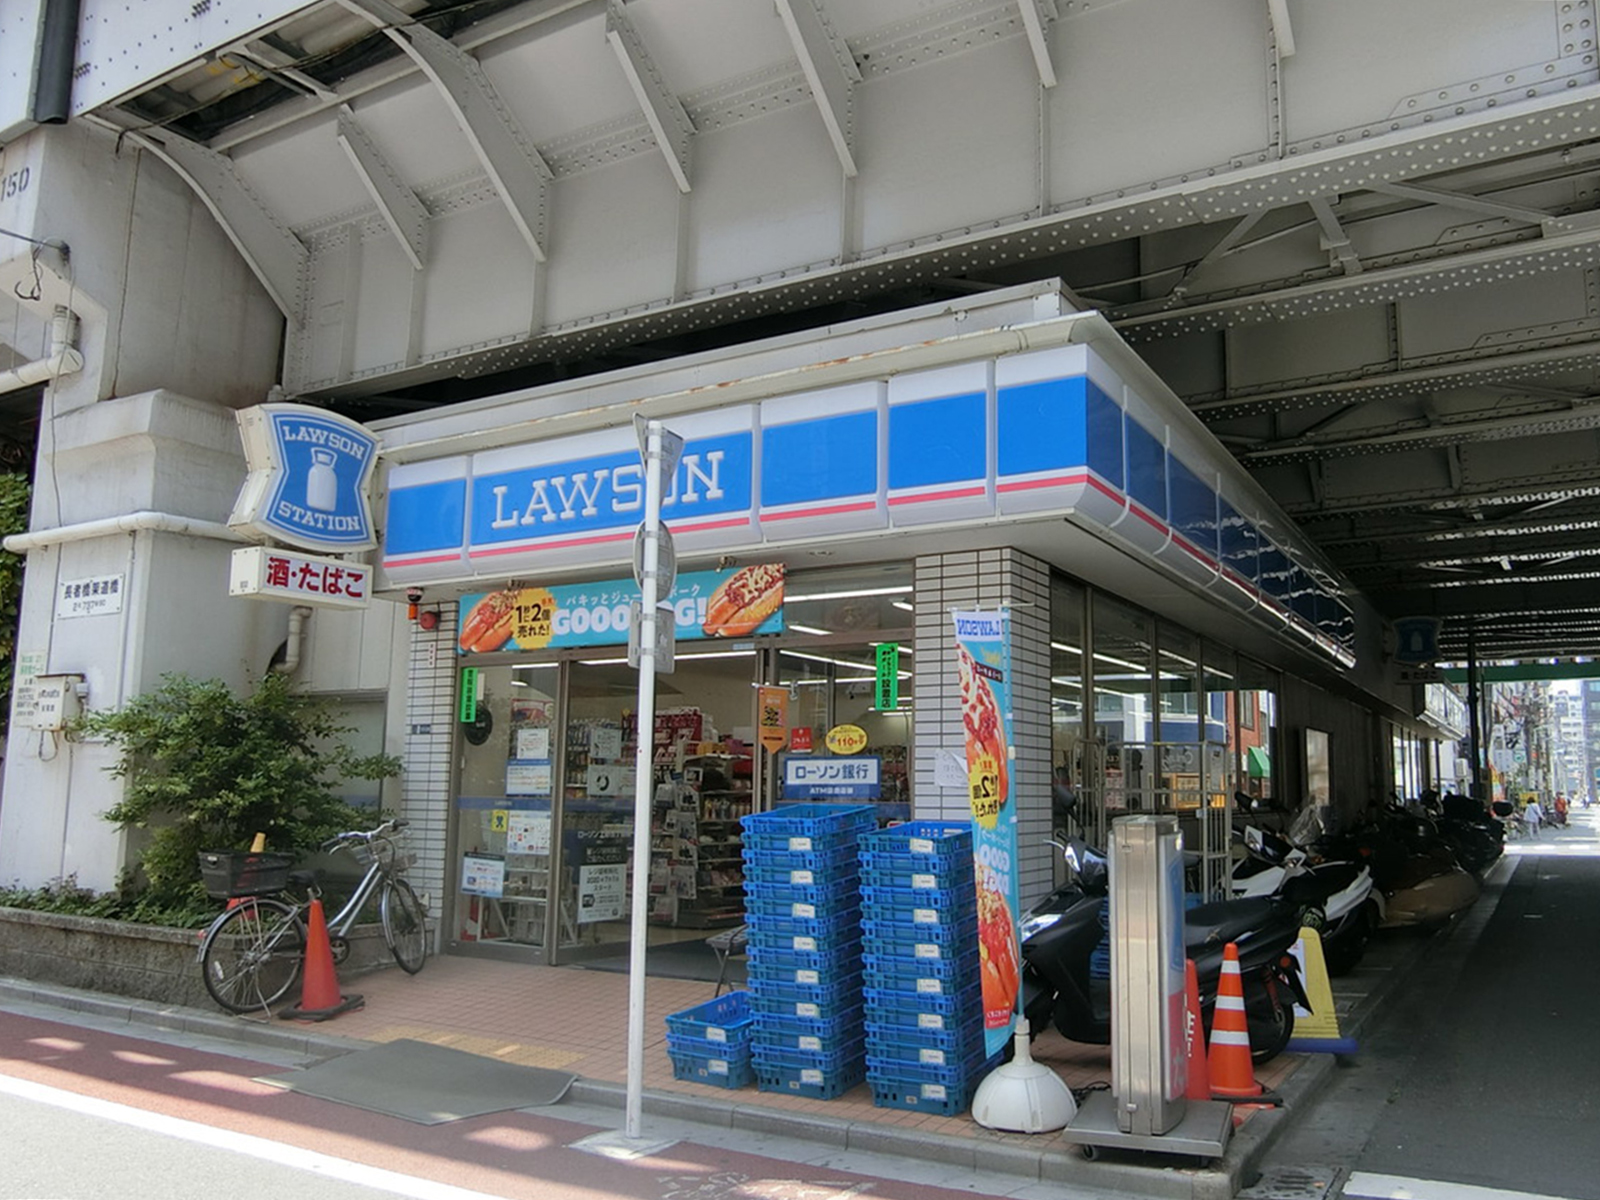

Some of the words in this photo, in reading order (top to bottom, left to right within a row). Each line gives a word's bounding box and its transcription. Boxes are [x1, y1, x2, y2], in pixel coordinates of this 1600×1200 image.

[282, 425, 366, 461] LAWSON
[492, 451, 725, 529] LAWSN
[277, 500, 361, 531] STATION
[266, 556, 364, 598] 酒・たばこ
[565, 585, 701, 606] パキッとジューポーク
[552, 596, 707, 636] GOOOG!
[795, 764, 869, 780] ローソン銀行
